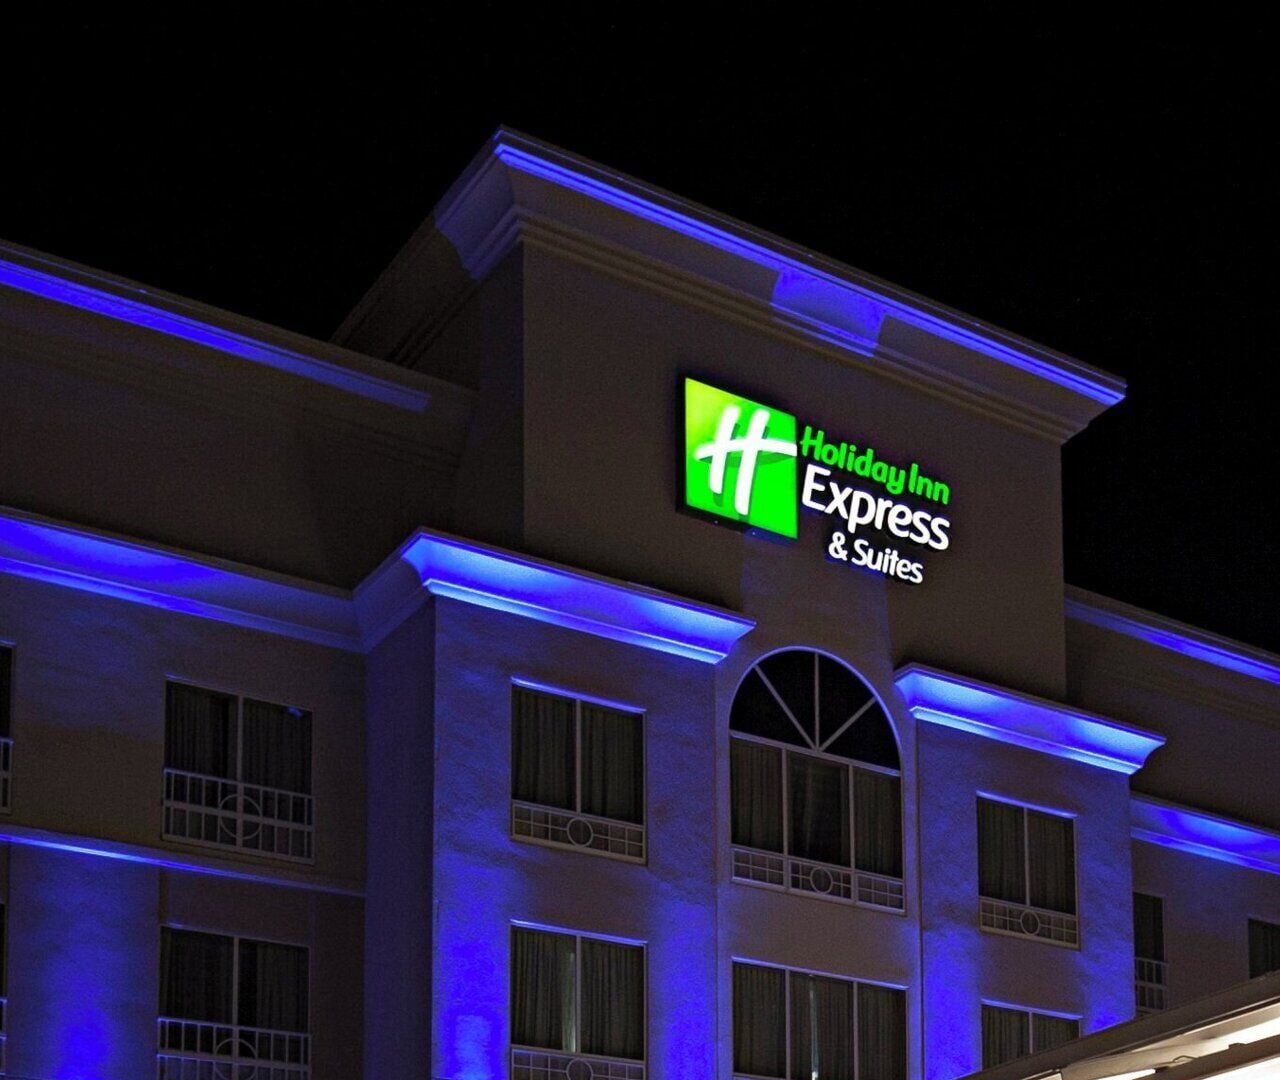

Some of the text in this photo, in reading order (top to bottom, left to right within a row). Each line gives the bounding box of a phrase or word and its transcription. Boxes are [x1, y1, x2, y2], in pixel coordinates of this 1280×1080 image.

[800, 424, 951, 506] Holiday Inn
[801, 463, 951, 551] Express
[827, 531, 924, 584] & Suites
